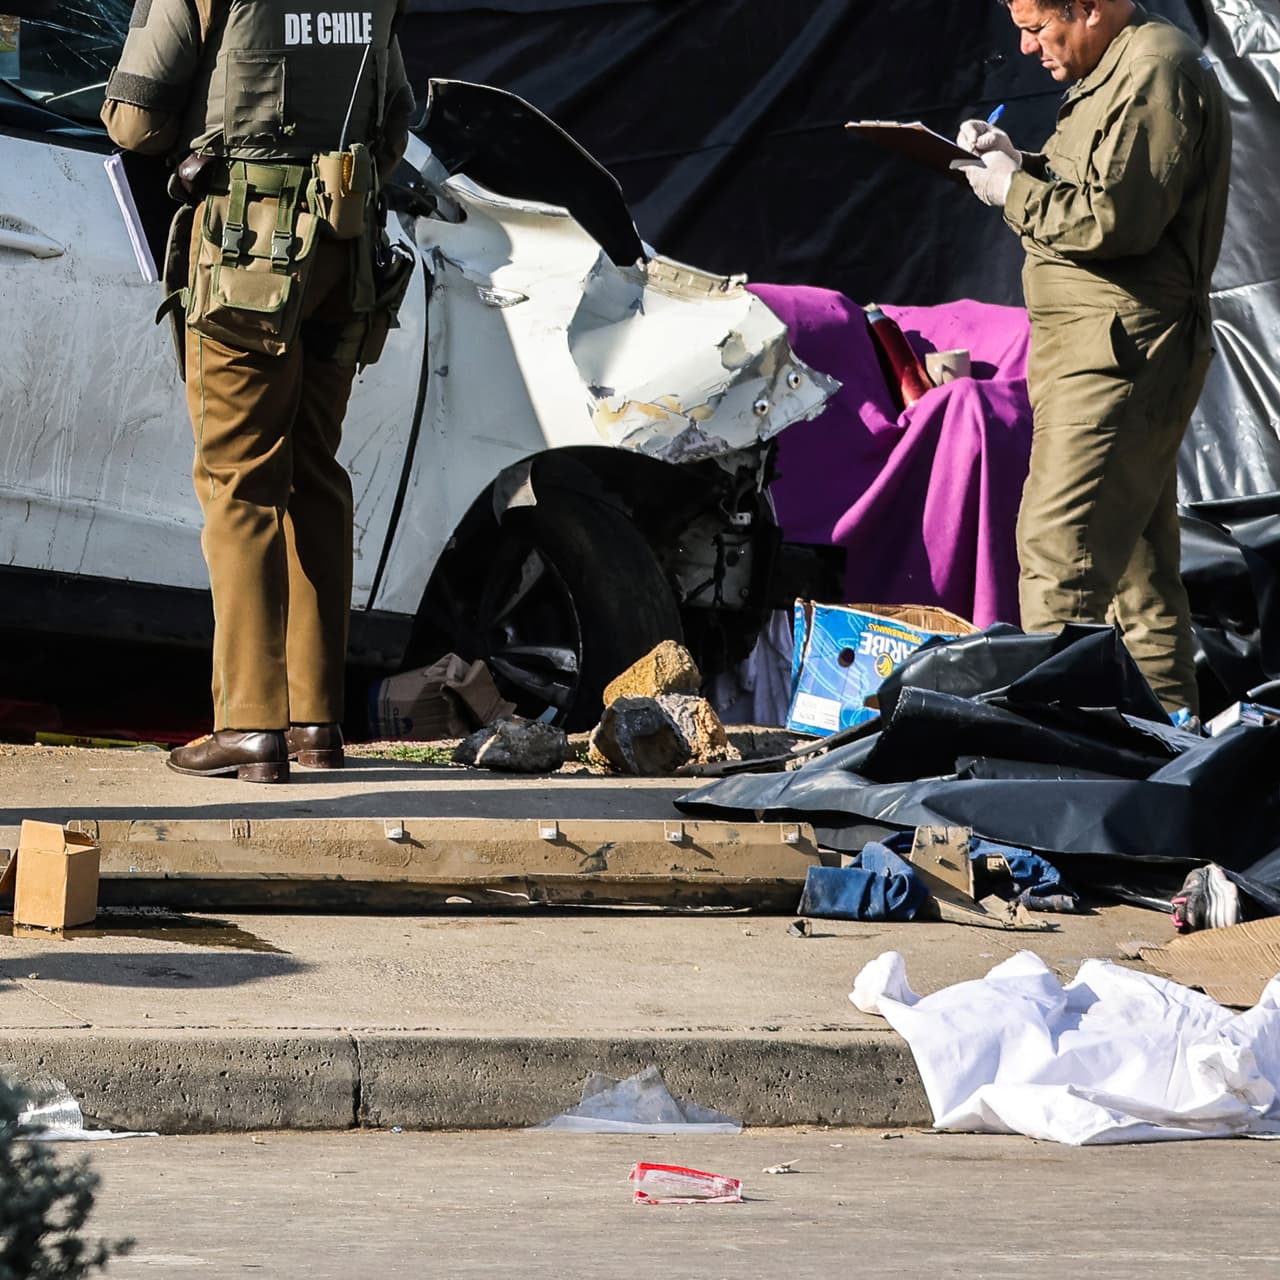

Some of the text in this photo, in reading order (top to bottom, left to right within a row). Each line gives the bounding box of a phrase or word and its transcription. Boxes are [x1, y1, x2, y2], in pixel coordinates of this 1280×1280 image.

[284, 11, 372, 45] DE CHILE
[857, 632, 920, 664] ARIBE
